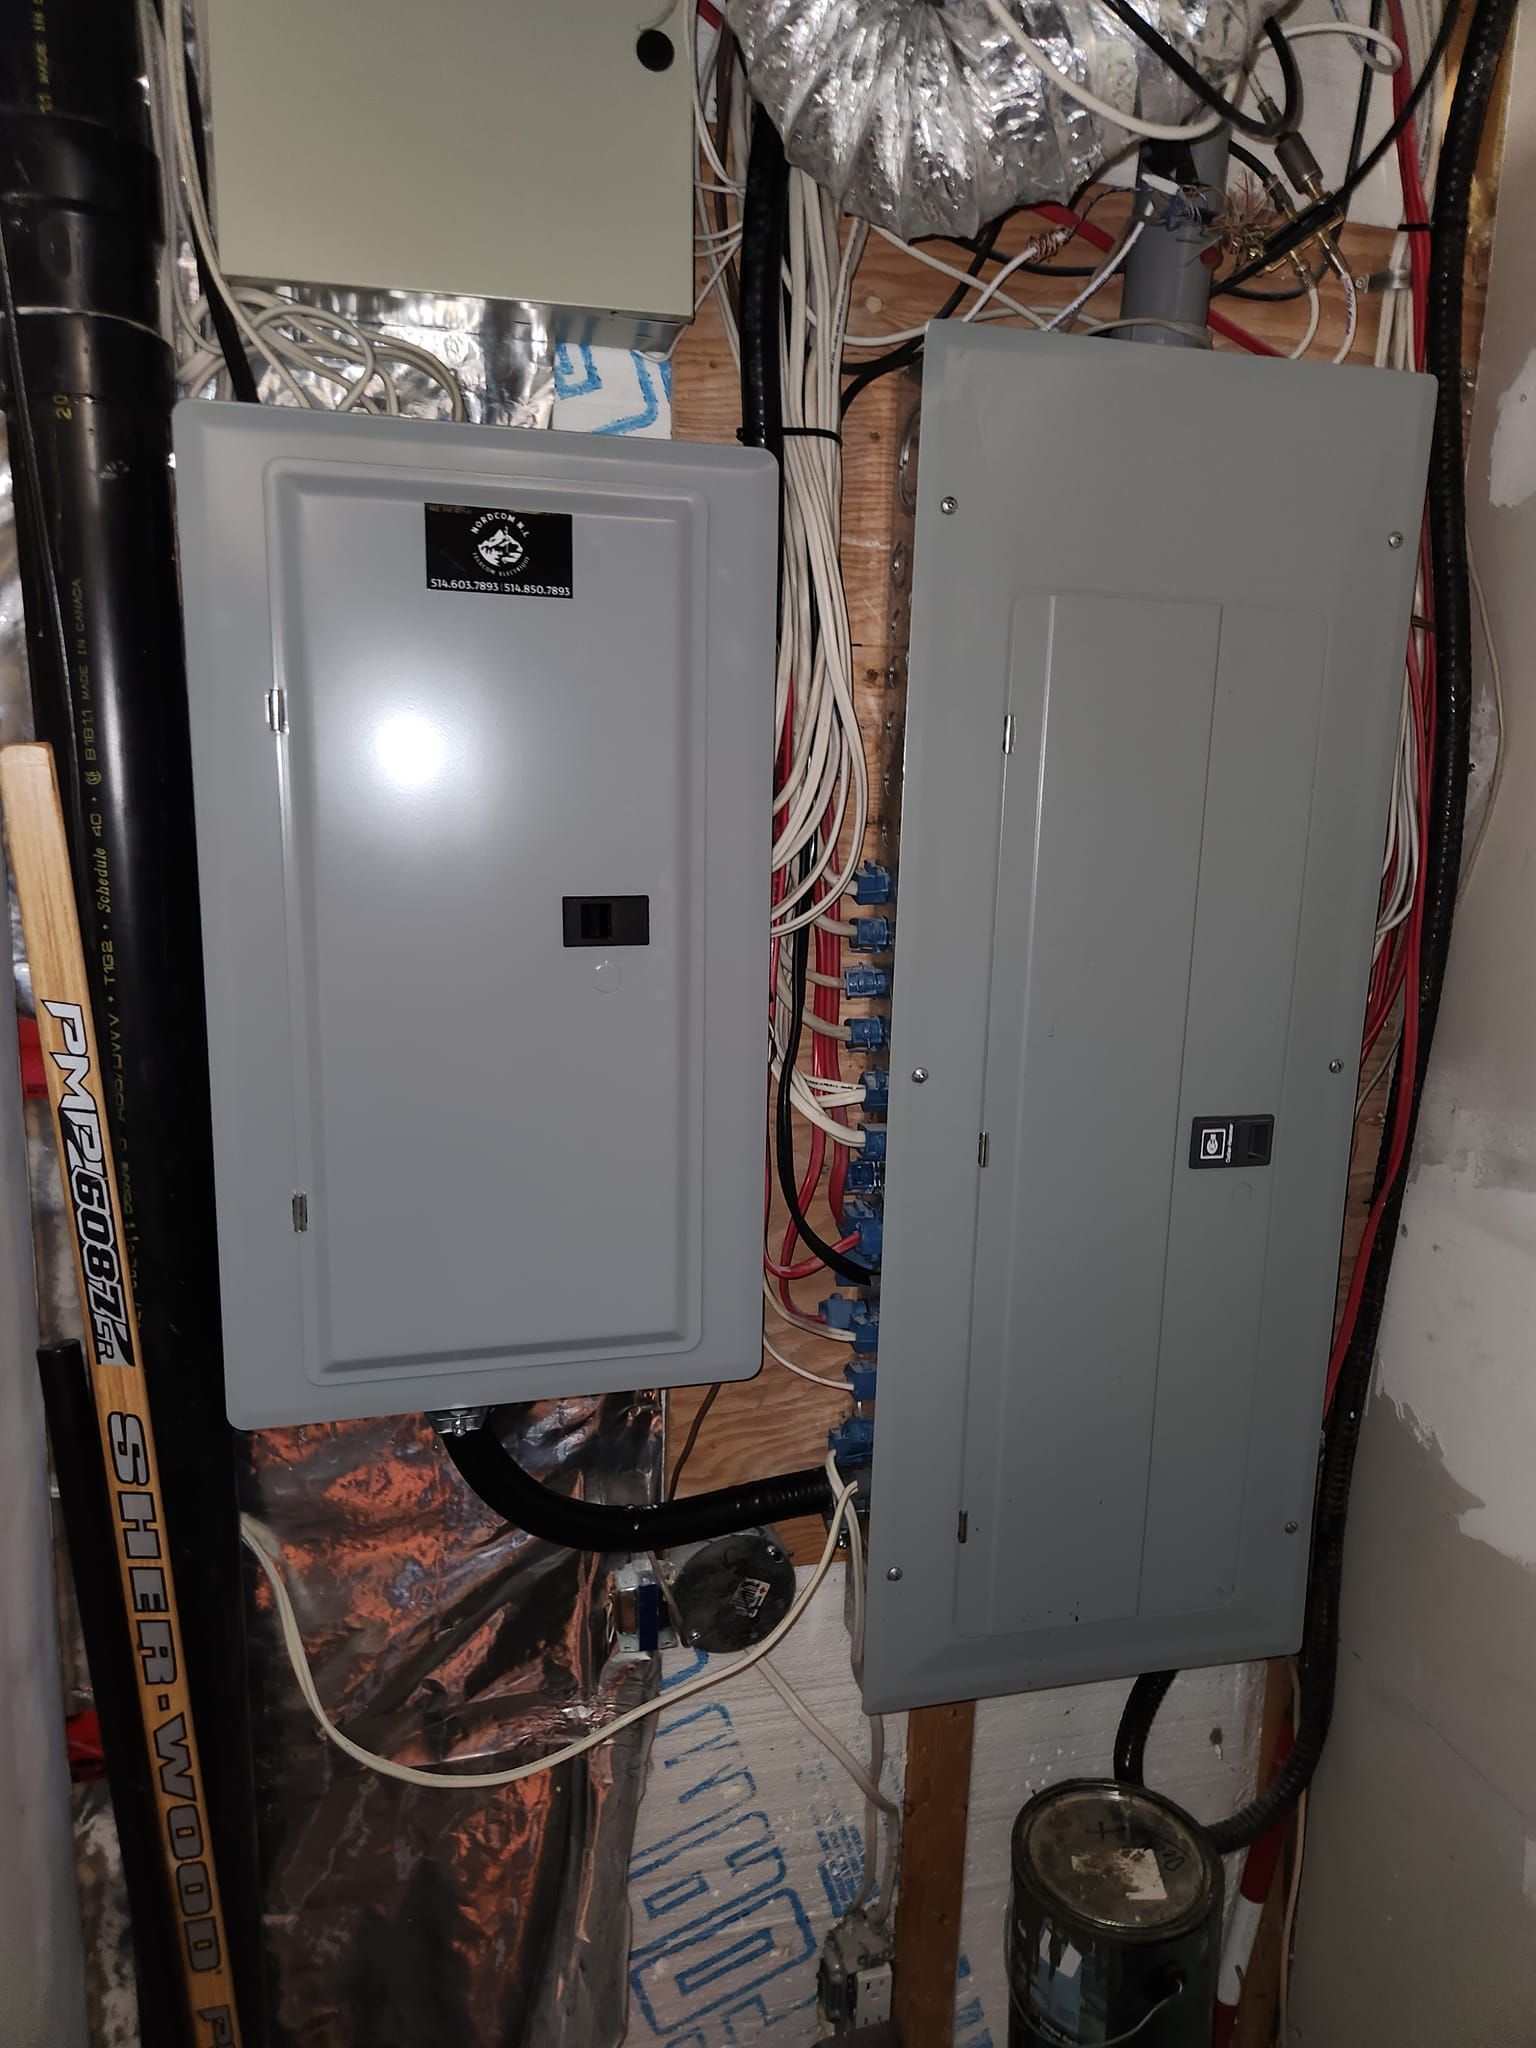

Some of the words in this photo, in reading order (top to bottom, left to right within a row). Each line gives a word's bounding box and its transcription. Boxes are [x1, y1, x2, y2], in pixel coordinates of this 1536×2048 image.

[53, 394, 72, 420] 20
[470, 512, 516, 535] NORDCOM
[431, 578, 499, 592] 514.603.7893
[504, 583, 571, 597] 514.850.7893
[71, 578, 86, 632] CANADA
[77, 640, 87, 655] IN
[78, 664, 89, 700] MADE
[90, 812, 103, 838] 40
[93, 847, 112, 914] Schedule
[107, 1410, 223, 1975] SHER-WOOD
